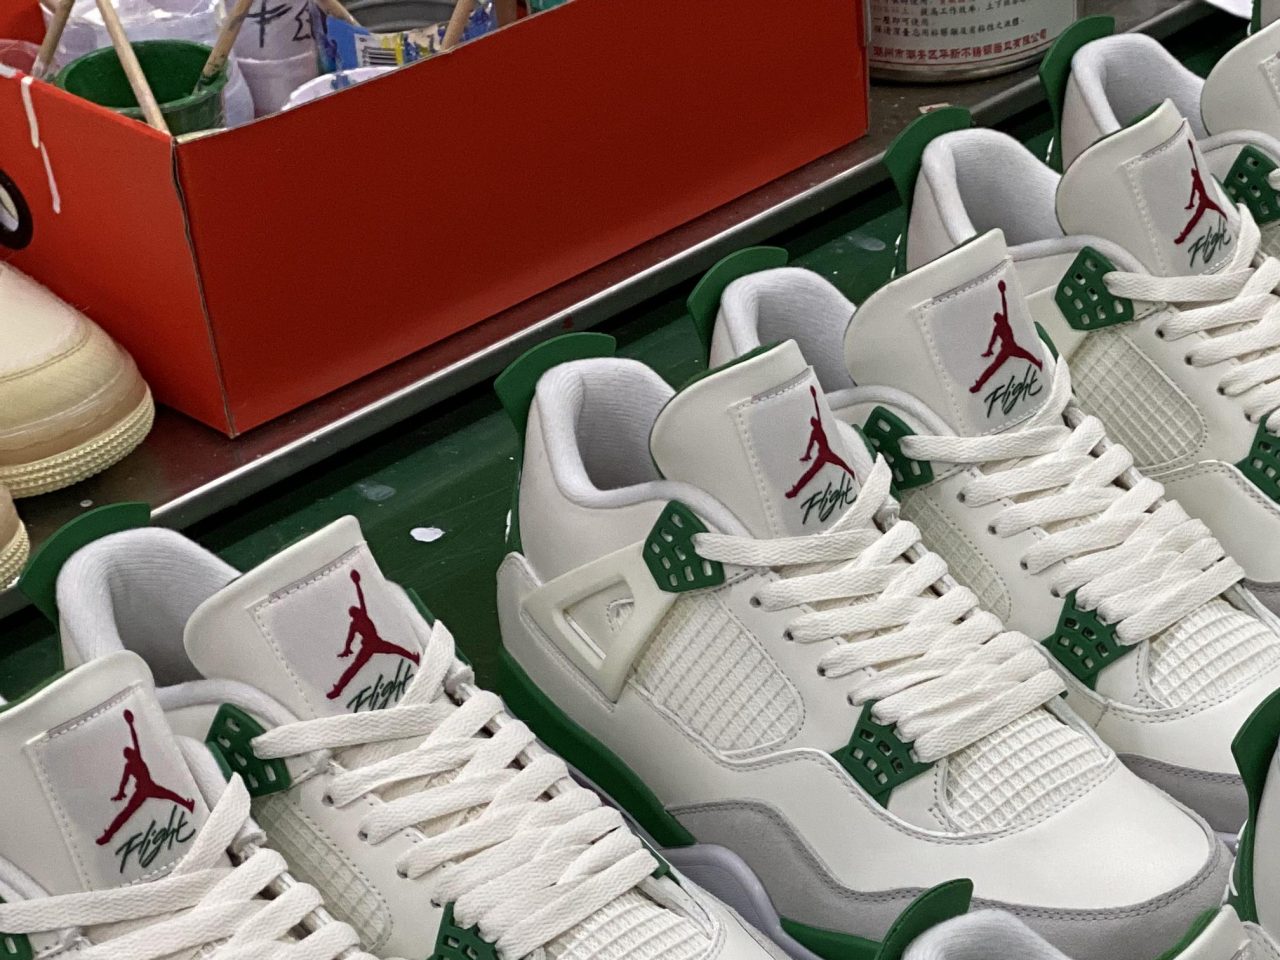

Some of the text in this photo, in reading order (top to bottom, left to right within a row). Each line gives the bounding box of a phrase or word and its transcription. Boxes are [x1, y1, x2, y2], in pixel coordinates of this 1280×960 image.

[1187, 218, 1231, 267] Flight
[984, 364, 1043, 417] Flight
[801, 472, 857, 524] Flight
[116, 806, 196, 872] Flight
